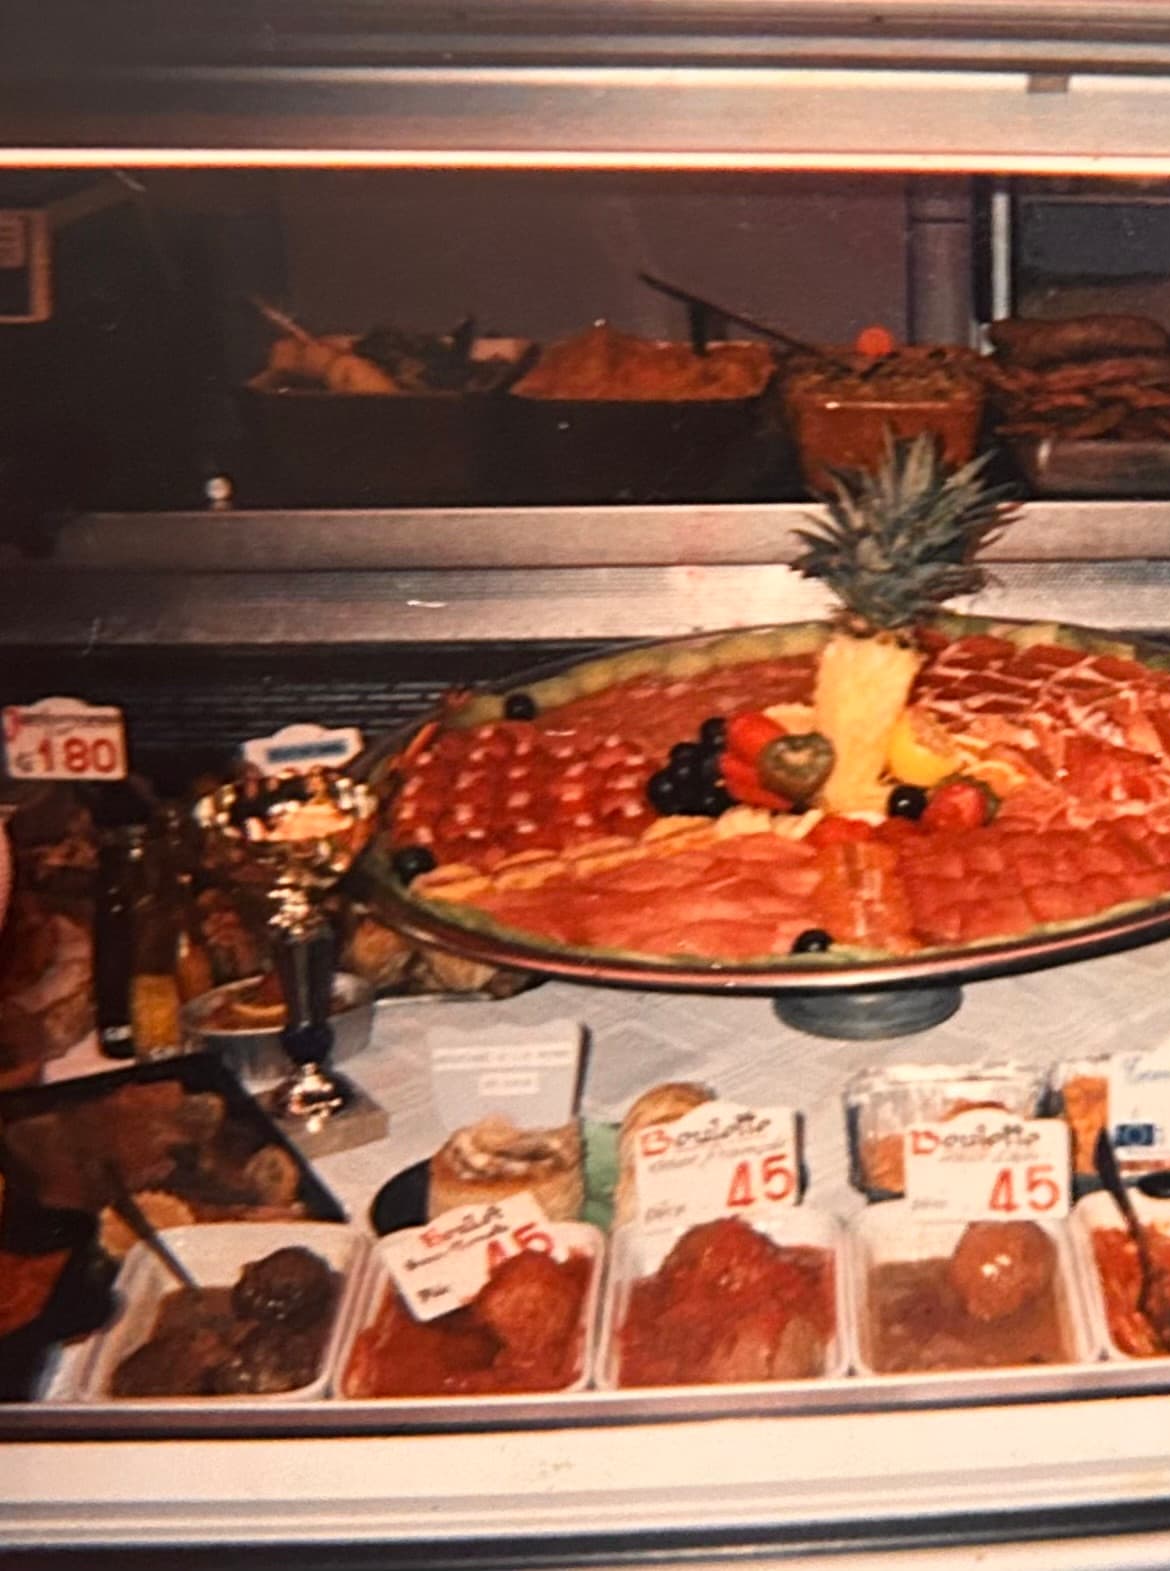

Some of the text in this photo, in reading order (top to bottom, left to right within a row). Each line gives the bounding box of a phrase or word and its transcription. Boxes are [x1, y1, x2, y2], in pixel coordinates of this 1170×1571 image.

[37, 737, 117, 773] 180
[726, 1154, 796, 1207] 45
[989, 1165, 1060, 1212] 45
